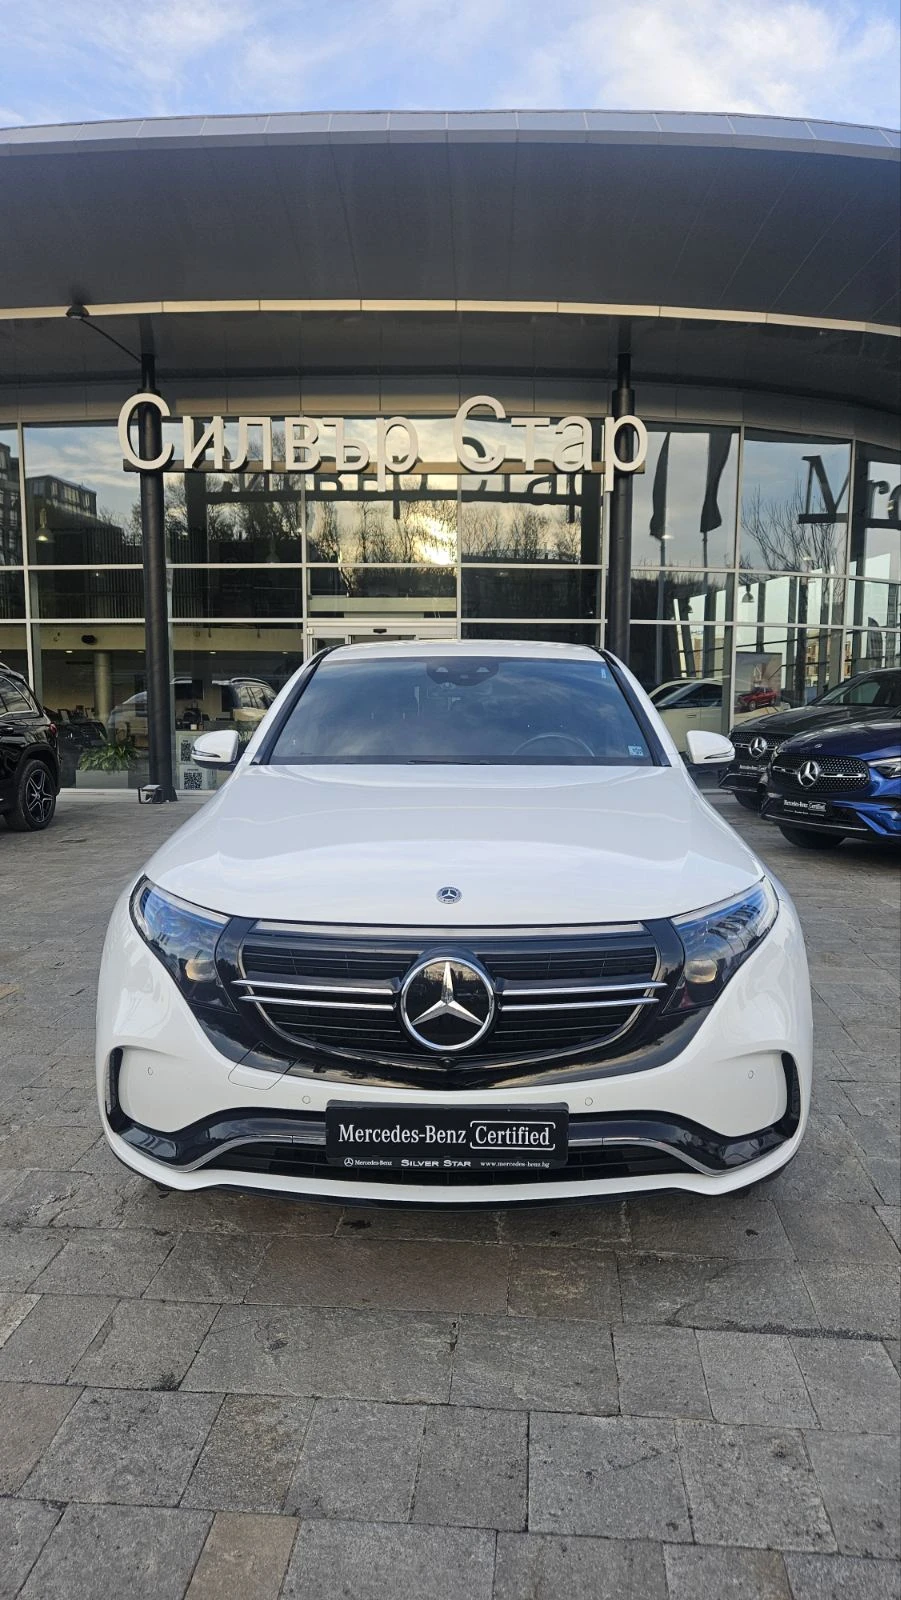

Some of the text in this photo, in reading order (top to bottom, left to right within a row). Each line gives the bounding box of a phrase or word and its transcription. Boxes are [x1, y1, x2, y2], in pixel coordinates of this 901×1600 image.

[118, 393, 648, 492] Силвър Стар
[338, 1124, 550, 1146] Mercedes-Benz Certified
[480, 1161, 550, 1169] www.mercedes-benz.bg
